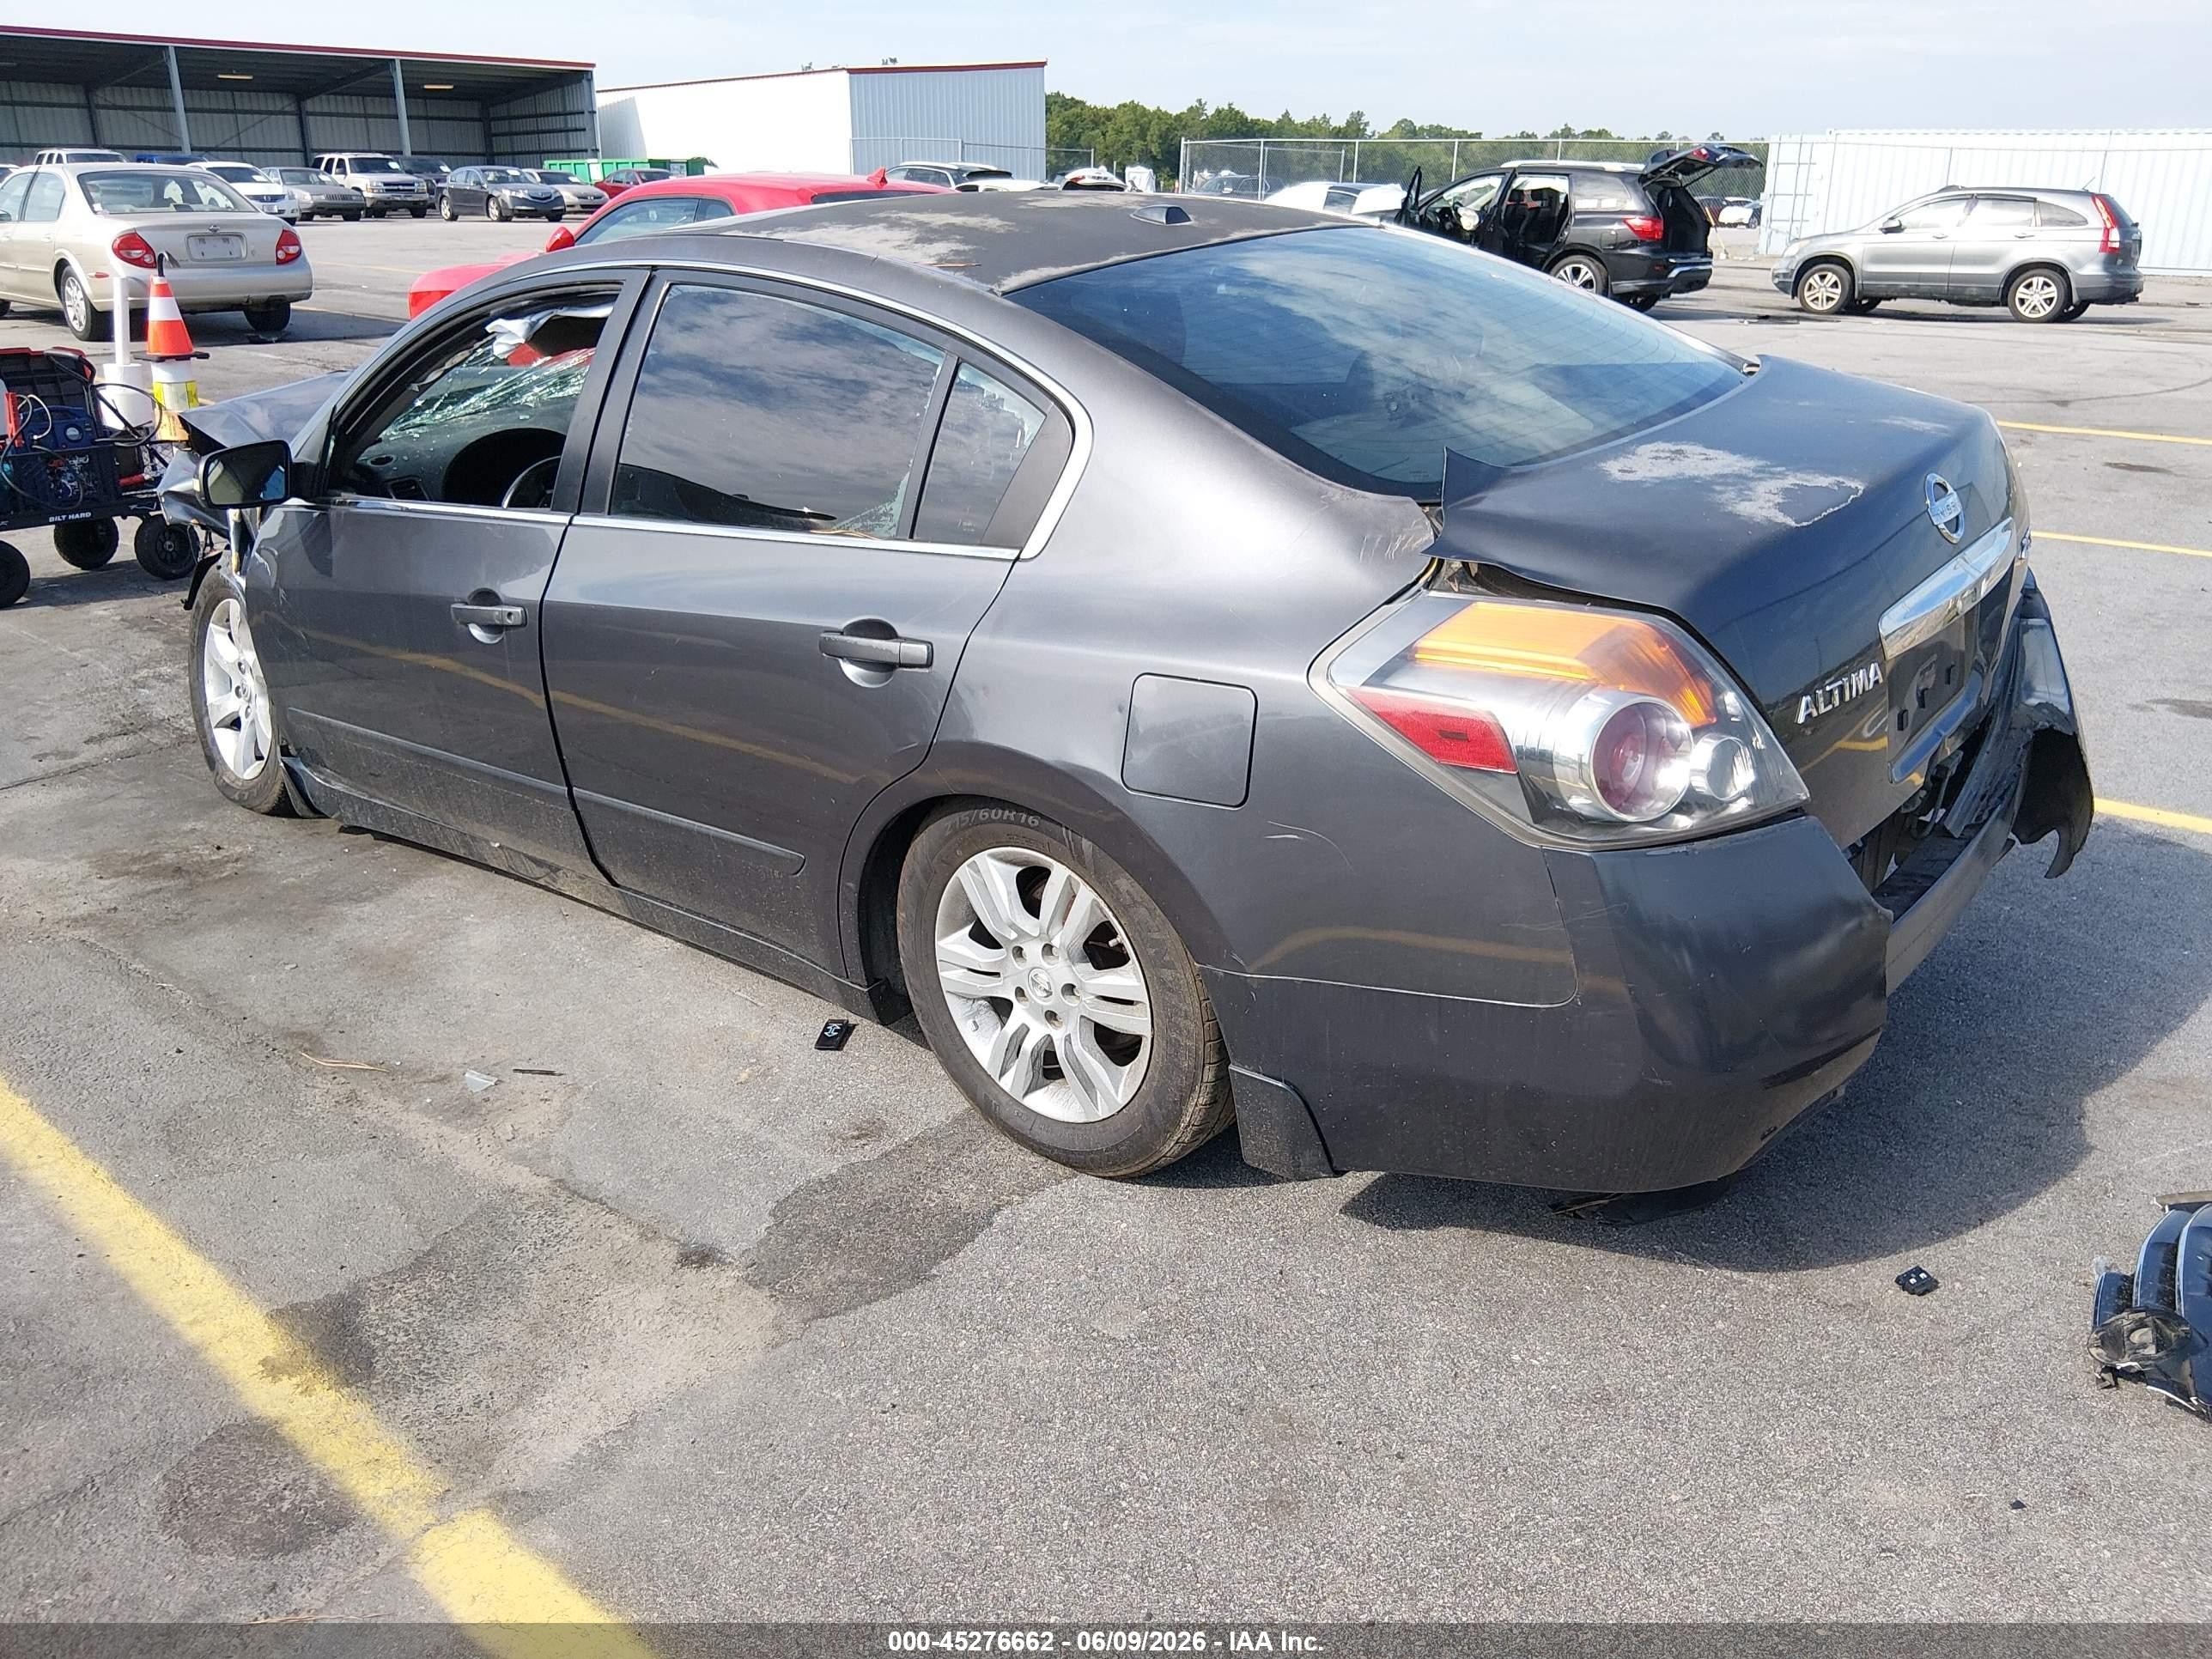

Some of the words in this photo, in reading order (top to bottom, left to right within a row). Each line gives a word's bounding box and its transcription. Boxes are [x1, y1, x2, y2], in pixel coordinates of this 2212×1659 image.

[49, 514, 67, 523] BILT
[68, 512, 92, 520] HARD
[1795, 662, 1883, 724] ALTIMA
